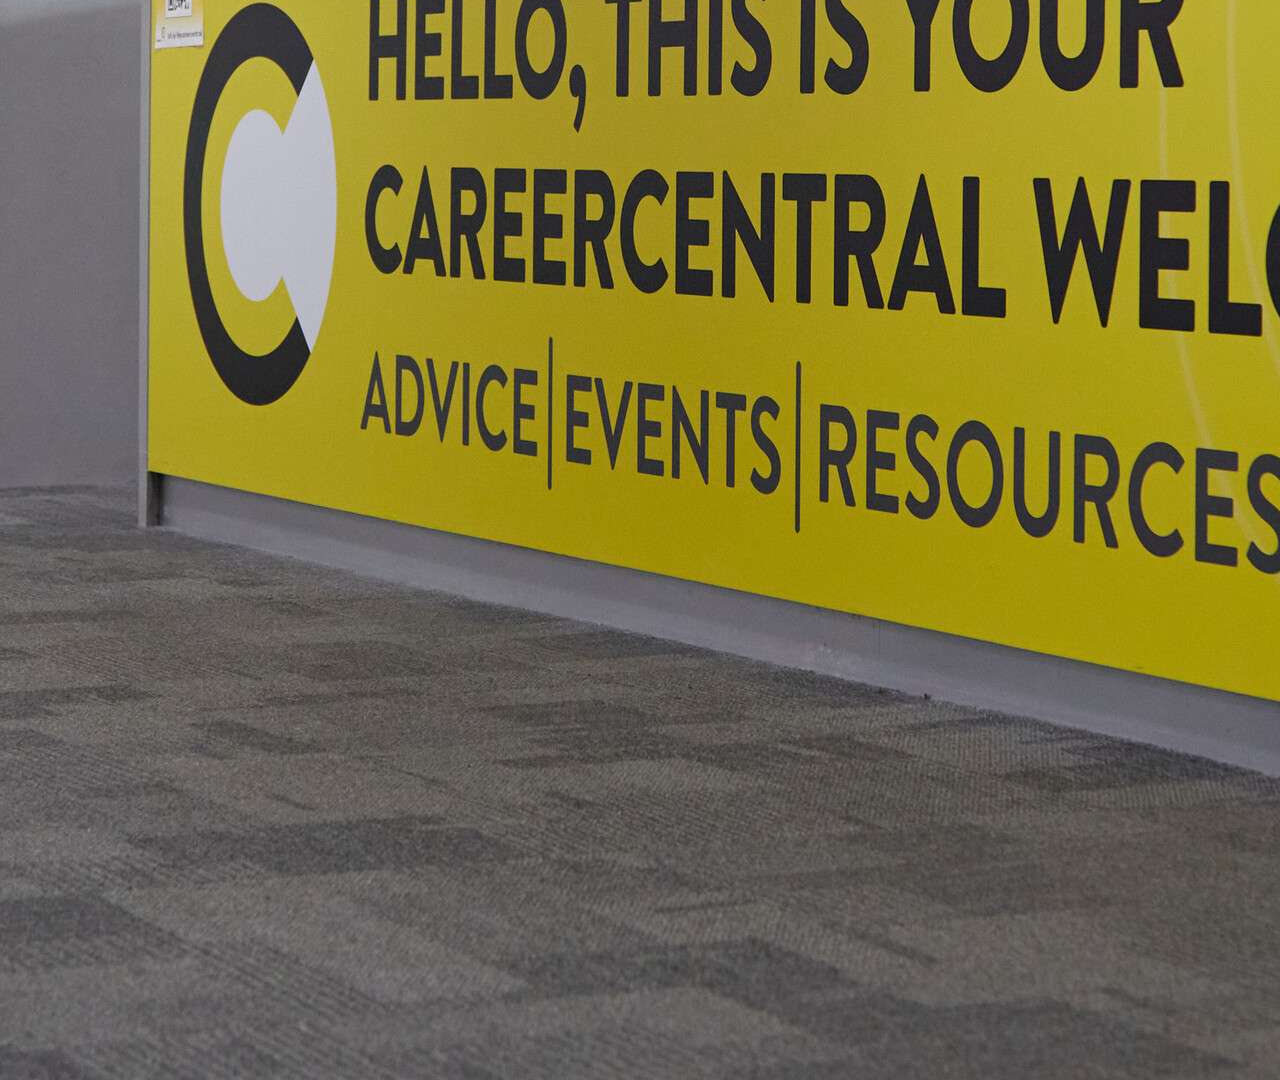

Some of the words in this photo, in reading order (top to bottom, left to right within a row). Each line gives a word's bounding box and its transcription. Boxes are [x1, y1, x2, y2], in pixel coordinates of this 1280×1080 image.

[364, 164, 1007, 319] CAREERCENTRAL
[360, 351, 539, 457] ADVICE
[565, 374, 782, 495] EVENTS
